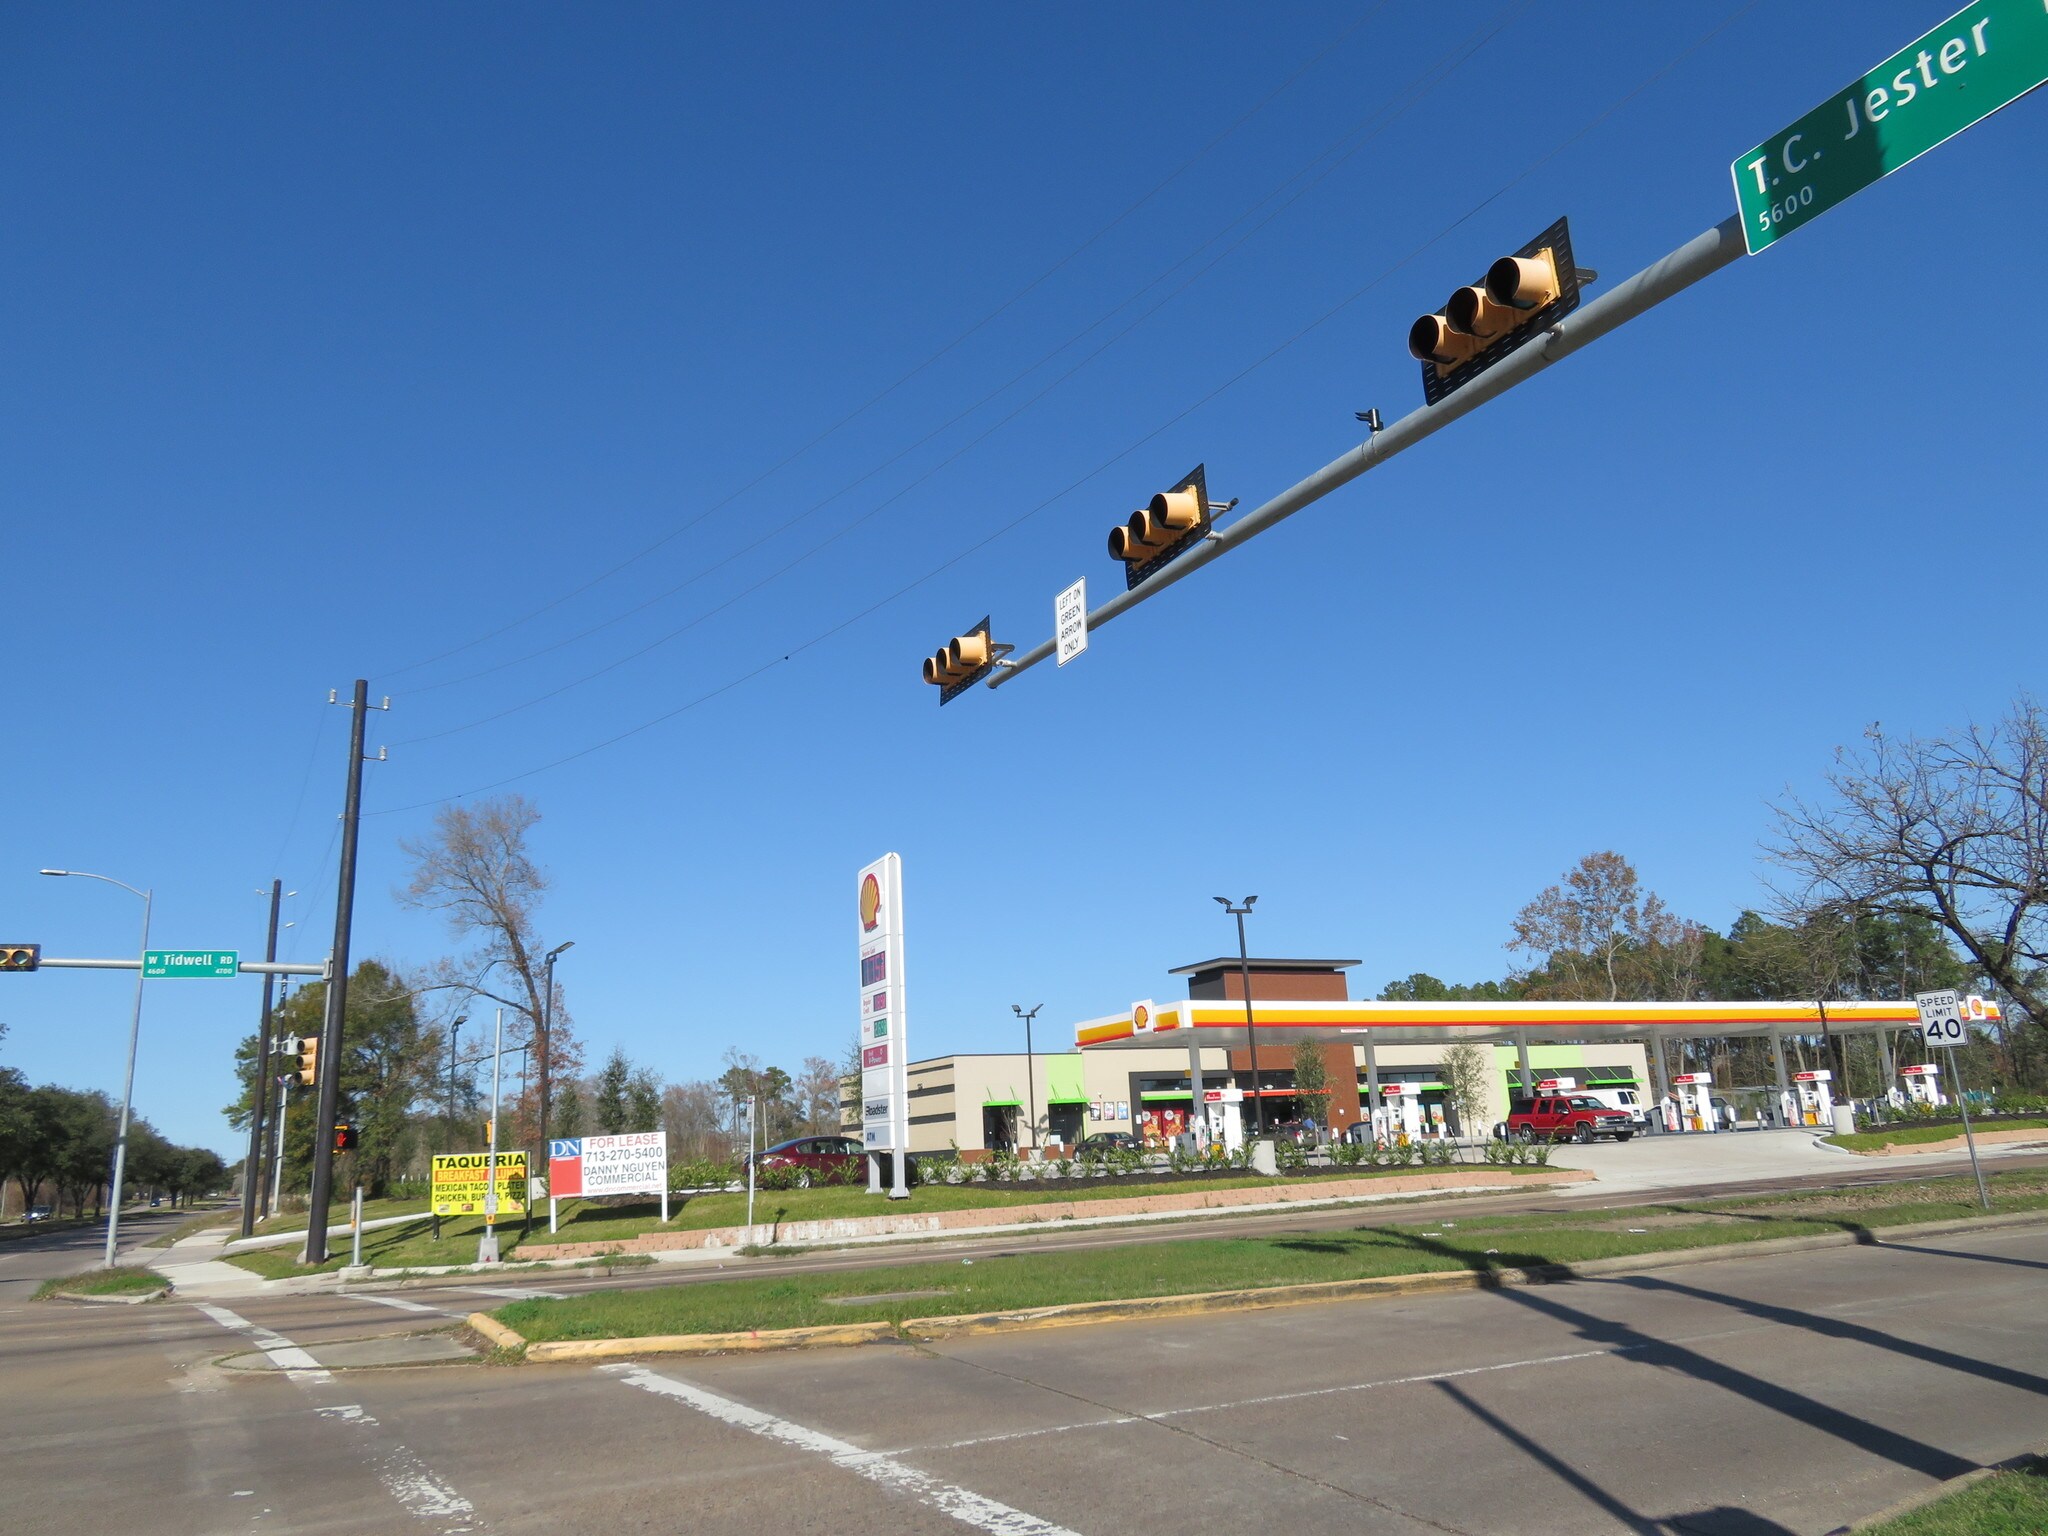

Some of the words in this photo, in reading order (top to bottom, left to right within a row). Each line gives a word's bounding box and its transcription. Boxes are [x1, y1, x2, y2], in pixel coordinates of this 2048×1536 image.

[1748, 134, 1821, 194] T.C.
[1844, 17, 1989, 140] Jester
[1759, 186, 1813, 232] 5600
[1060, 592, 1072, 610] LEFT
[1073, 586, 1081, 600] ON
[1061, 603, 1081, 625] GREEN
[1061, 618, 1082, 641] ARROW
[1064, 637, 1079, 655] ONLY
[148, 956, 158, 965] W
[164, 954, 212, 966] Tidwell
[220, 956, 233, 965] RD
[1920, 996, 1954, 1008] SPEED
[1926, 1007, 1952, 1018] LIMIT
[1927, 1018, 1961, 1039] 40
[550, 1140, 580, 1157] DN
[590, 1138, 615, 1149] FOR
[619, 1134, 658, 1147] LEASE
[436, 1155, 526, 1168] TAQUERIA
[586, 1147, 663, 1162] 713-270-5400
[438, 1170, 485, 1182] BREAKFAST
[584, 1164, 619, 1176] DANNY
[622, 1161, 665, 1173] NGUYEN
[435, 1183, 468, 1192] MEXICAN
[470, 1183, 489, 1191] TACO
[498, 1181, 525, 1190] PLATER
[588, 1172, 658, 1186] COMMERCIAL
[505, 1191, 526, 1200] PIZZA
